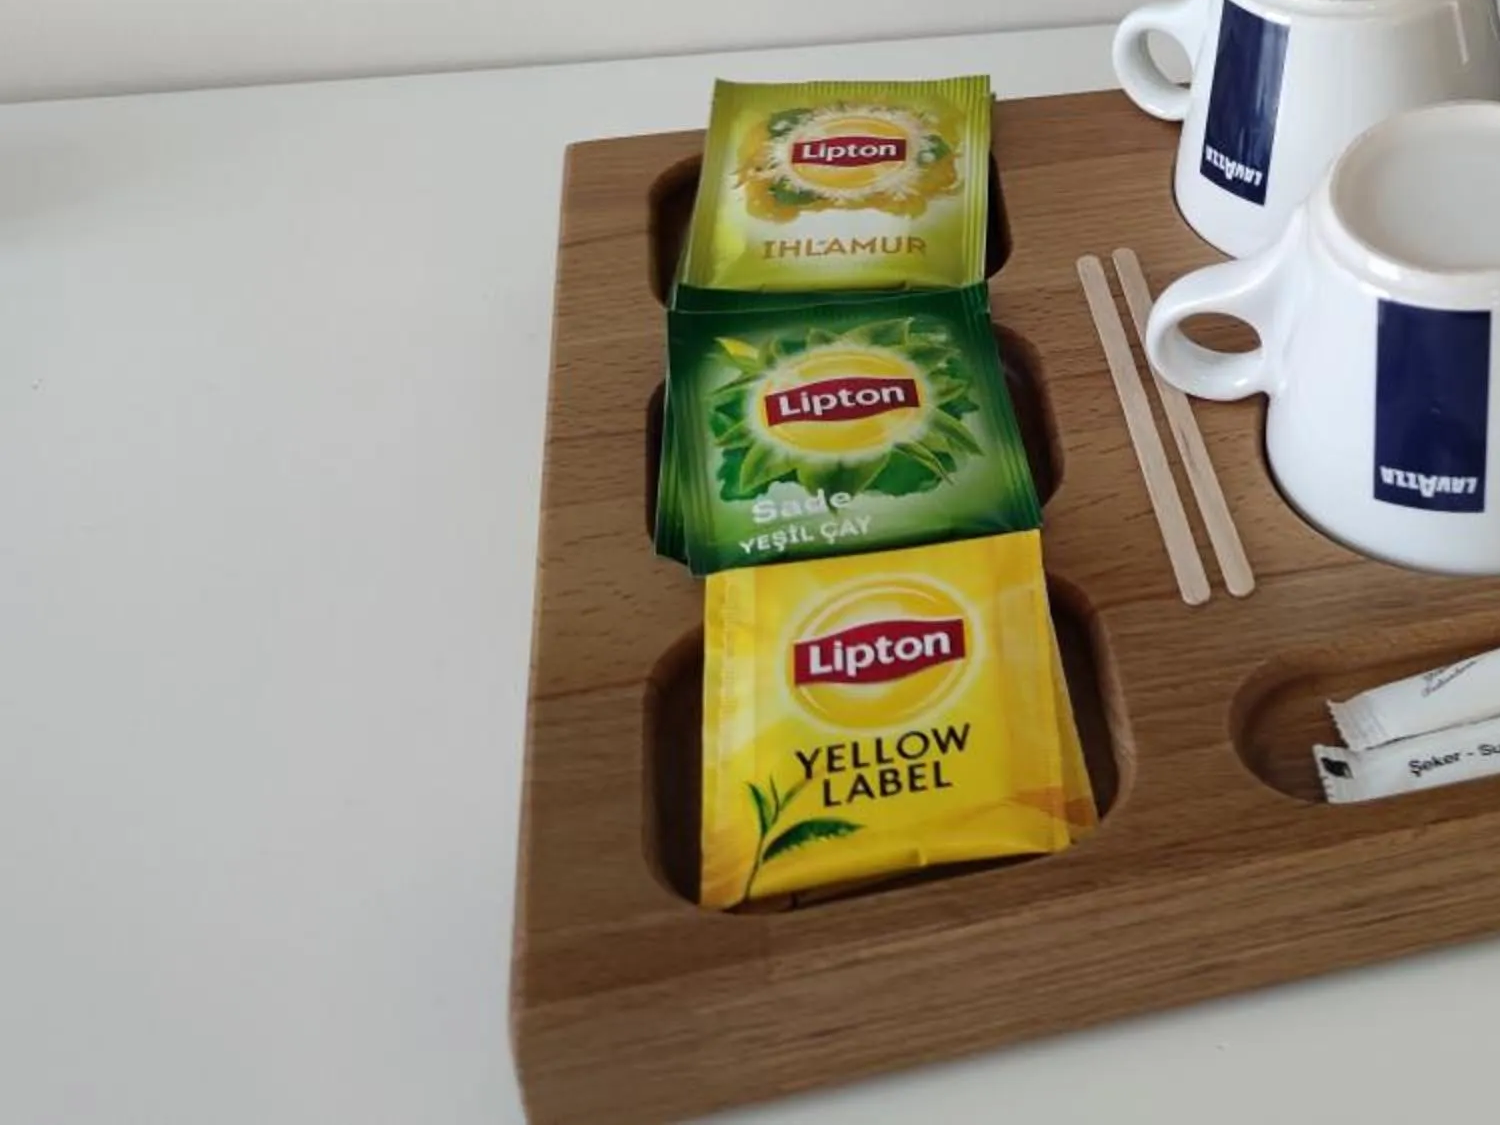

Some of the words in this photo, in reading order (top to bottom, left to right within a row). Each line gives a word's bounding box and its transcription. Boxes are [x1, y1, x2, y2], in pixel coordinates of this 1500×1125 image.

[802, 139, 897, 163] Lipton
[1206, 145, 1263, 186] LAVAZZA
[763, 236, 927, 260] IHLAMUR
[780, 383, 906, 416] Lipton
[1380, 465, 1477, 497] LAVAZZA
[752, 488, 850, 523] Sade
[820, 515, 871, 544] ÇAY
[808, 630, 950, 675] Lipton
[795, 724, 971, 779] YELLOW
[1408, 751, 1462, 776] Şeker
[823, 763, 952, 807] LABEL
